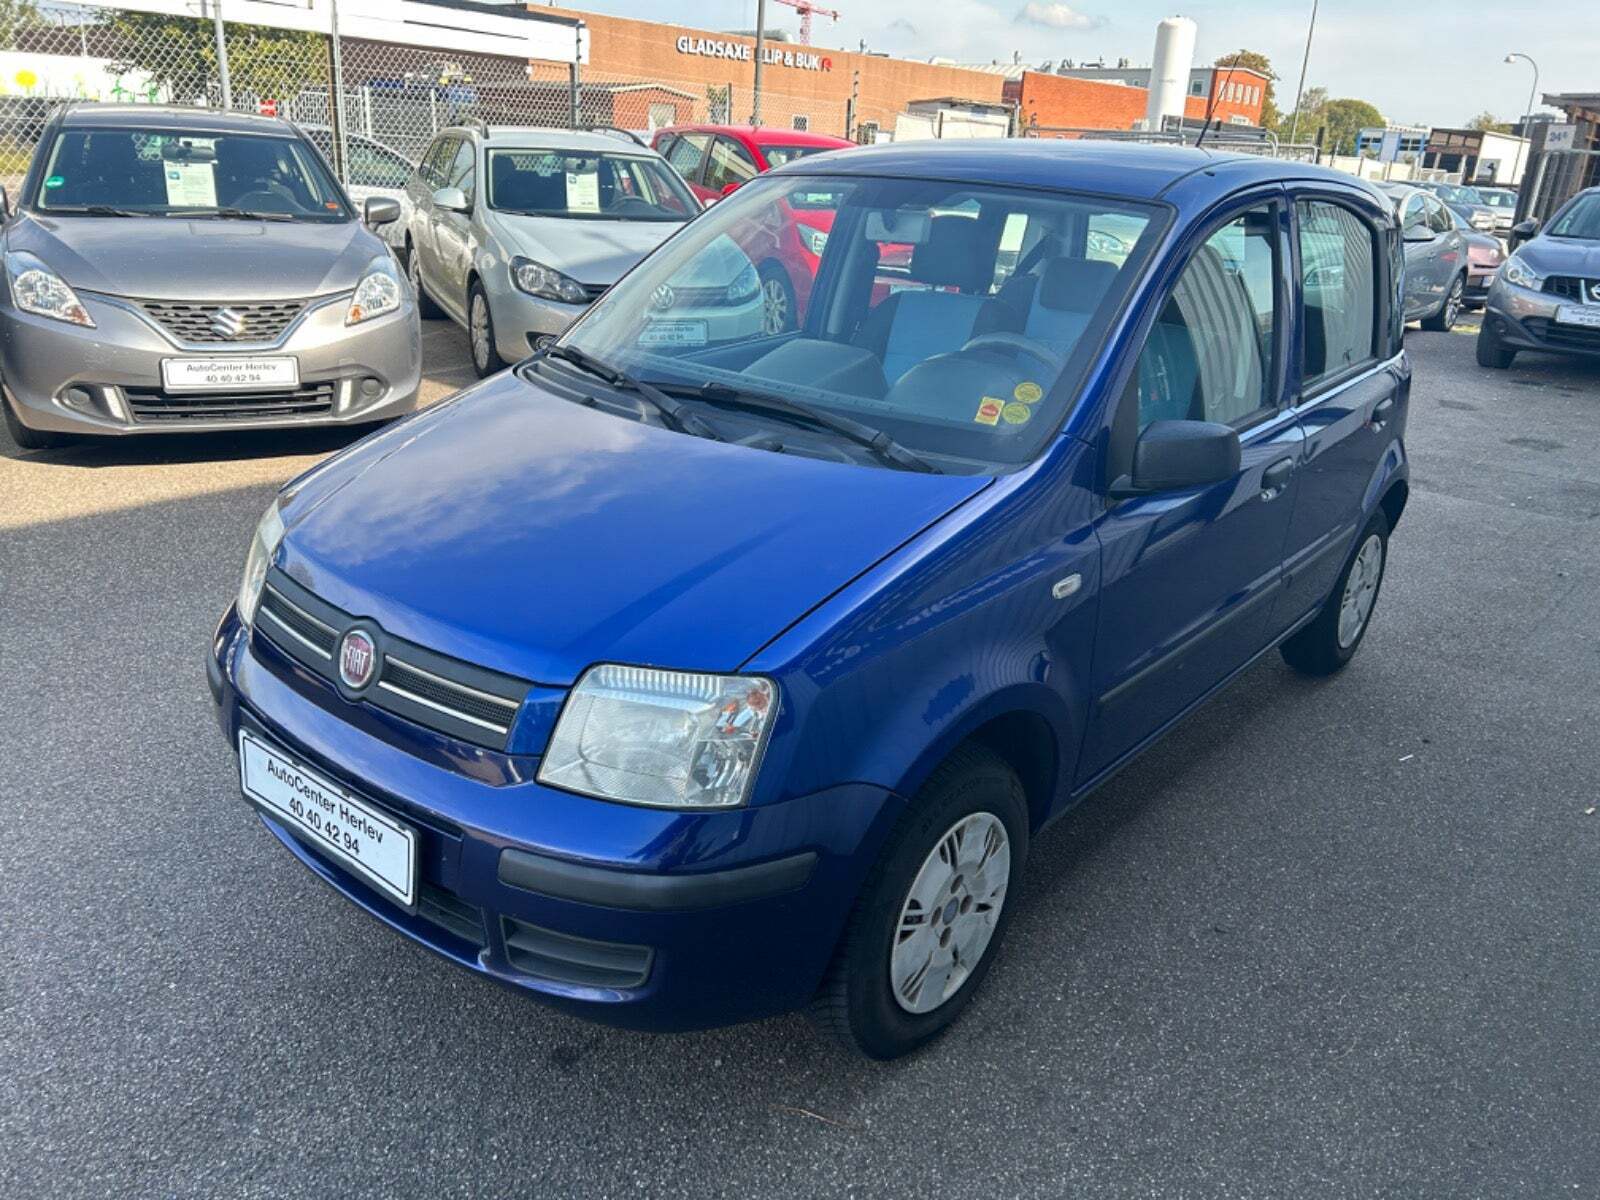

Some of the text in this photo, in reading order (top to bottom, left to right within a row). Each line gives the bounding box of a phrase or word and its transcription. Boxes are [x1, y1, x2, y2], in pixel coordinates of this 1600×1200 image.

[677, 35, 751, 62] GLADSAXE
[756, 46, 783, 65] LIP
[187, 363, 242, 372] AutoCenter
[267, 758, 384, 844] AutoCenter Herlev
[289, 796, 361, 856] 40 40 42 94
